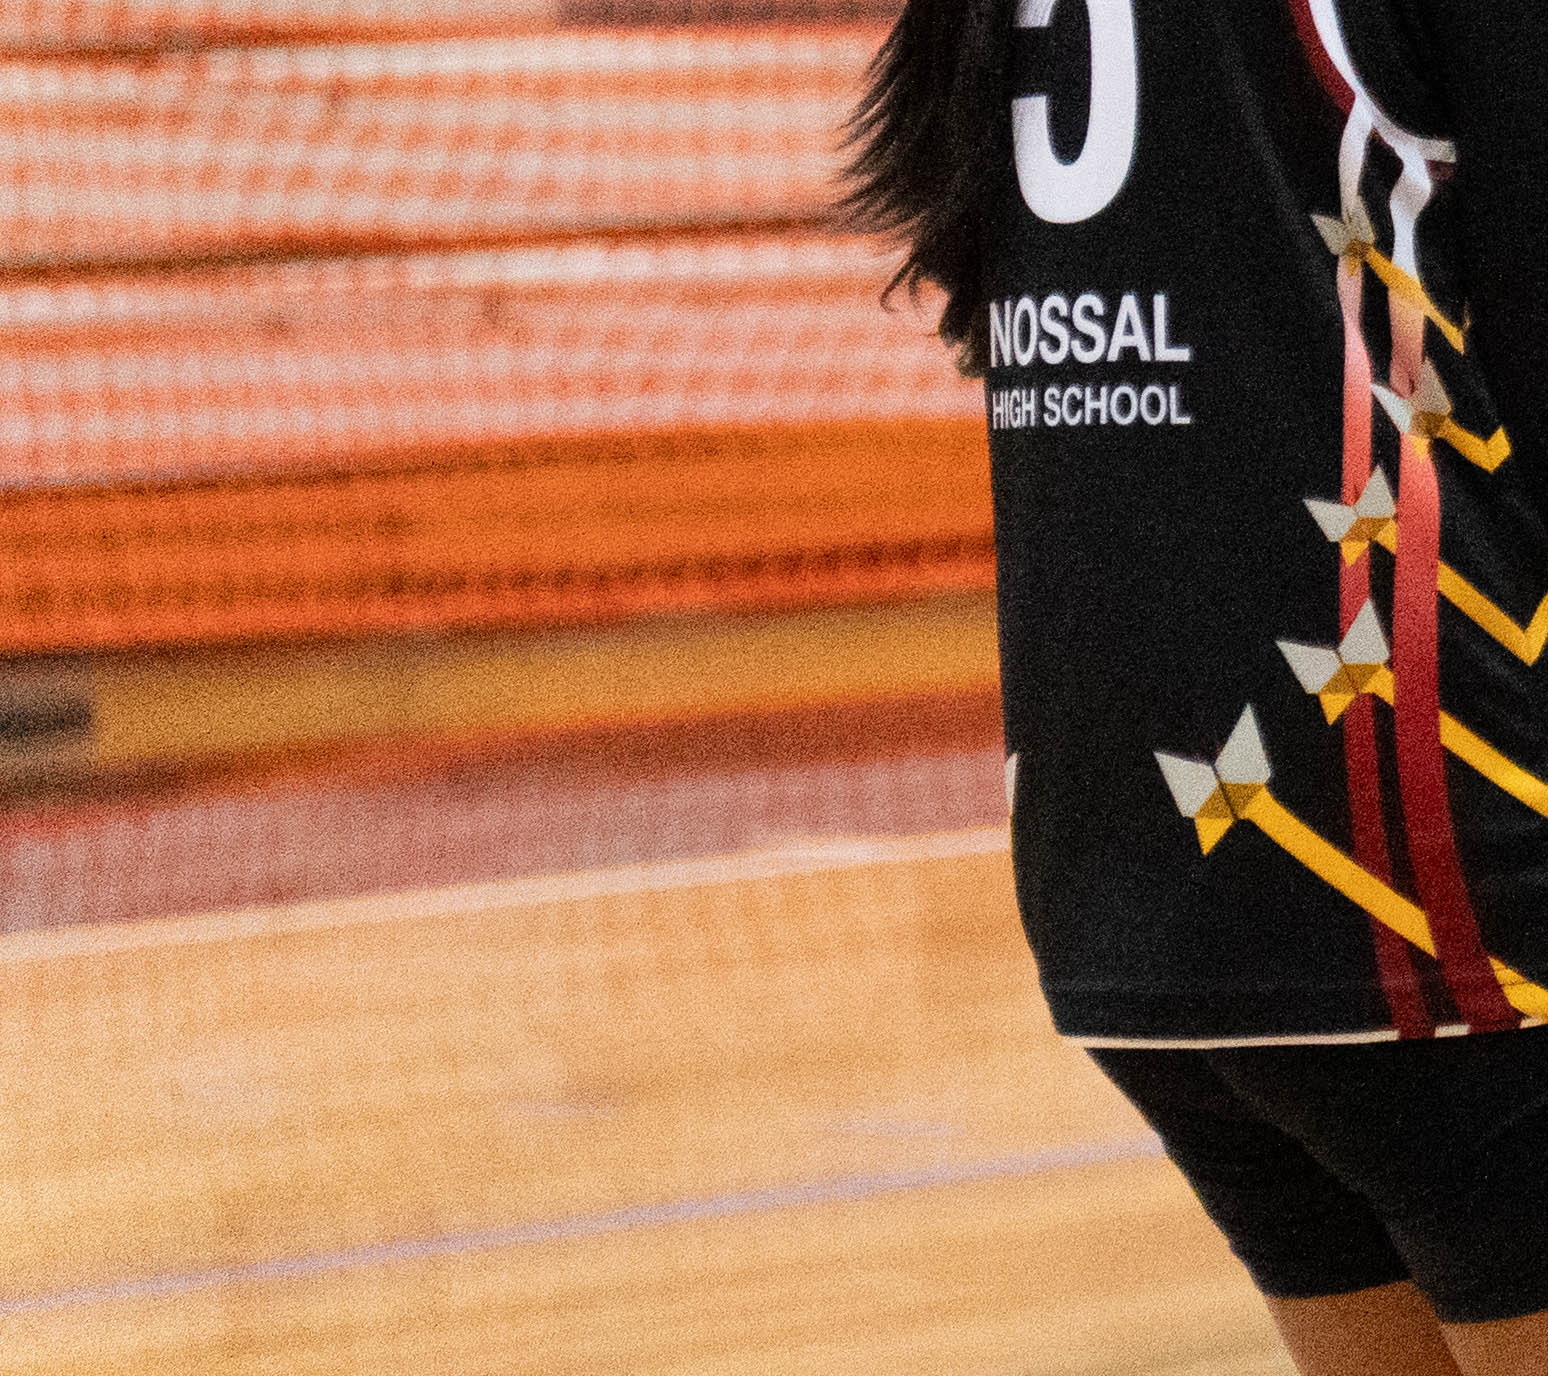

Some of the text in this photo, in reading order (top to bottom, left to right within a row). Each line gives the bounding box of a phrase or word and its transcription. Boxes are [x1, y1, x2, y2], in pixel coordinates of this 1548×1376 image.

[989, 294, 1191, 368] NOSSAL
[992, 385, 1191, 430] HIGH SCHOOL
